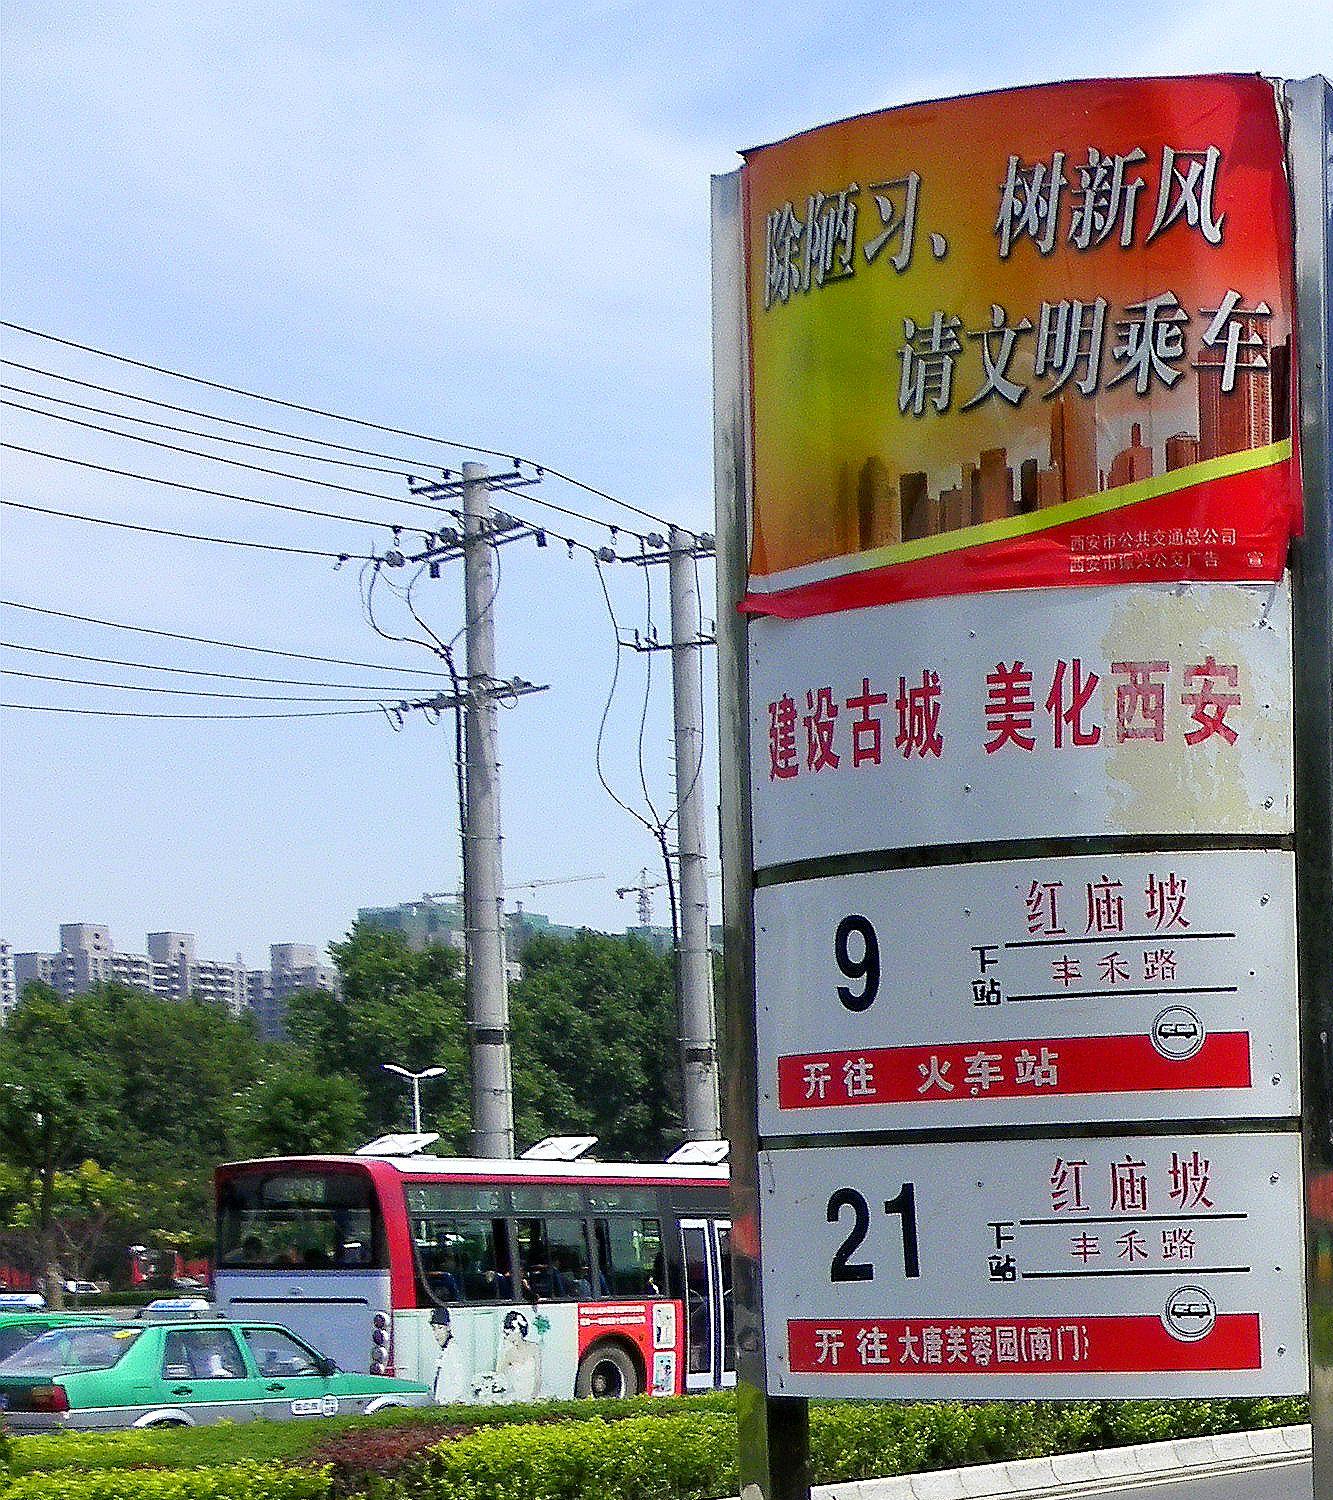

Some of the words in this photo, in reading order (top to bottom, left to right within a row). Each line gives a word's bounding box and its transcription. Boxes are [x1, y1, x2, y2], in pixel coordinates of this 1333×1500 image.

[763, 169, 948, 310] 除陋习、
[995, 144, 1227, 258] 树新风
[898, 288, 1273, 417] 请文明乘车
[1070, 527, 1236, 551] 西安市公共交通总公司
[768, 669, 943, 781] 建设古城
[985, 655, 1242, 755] 美化西安
[1025, 872, 1192, 936] 红庙坡
[834, 914, 881, 1012] 9
[1051, 948, 1178, 987] 丰禾路
[802, 1059, 878, 1100] 开往
[917, 1048, 1059, 1094] 火车站
[1050, 1152, 1216, 1212] 红庙坡
[826, 1183, 920, 1282] 21
[1070, 1228, 1196, 1263] 丰禾路
